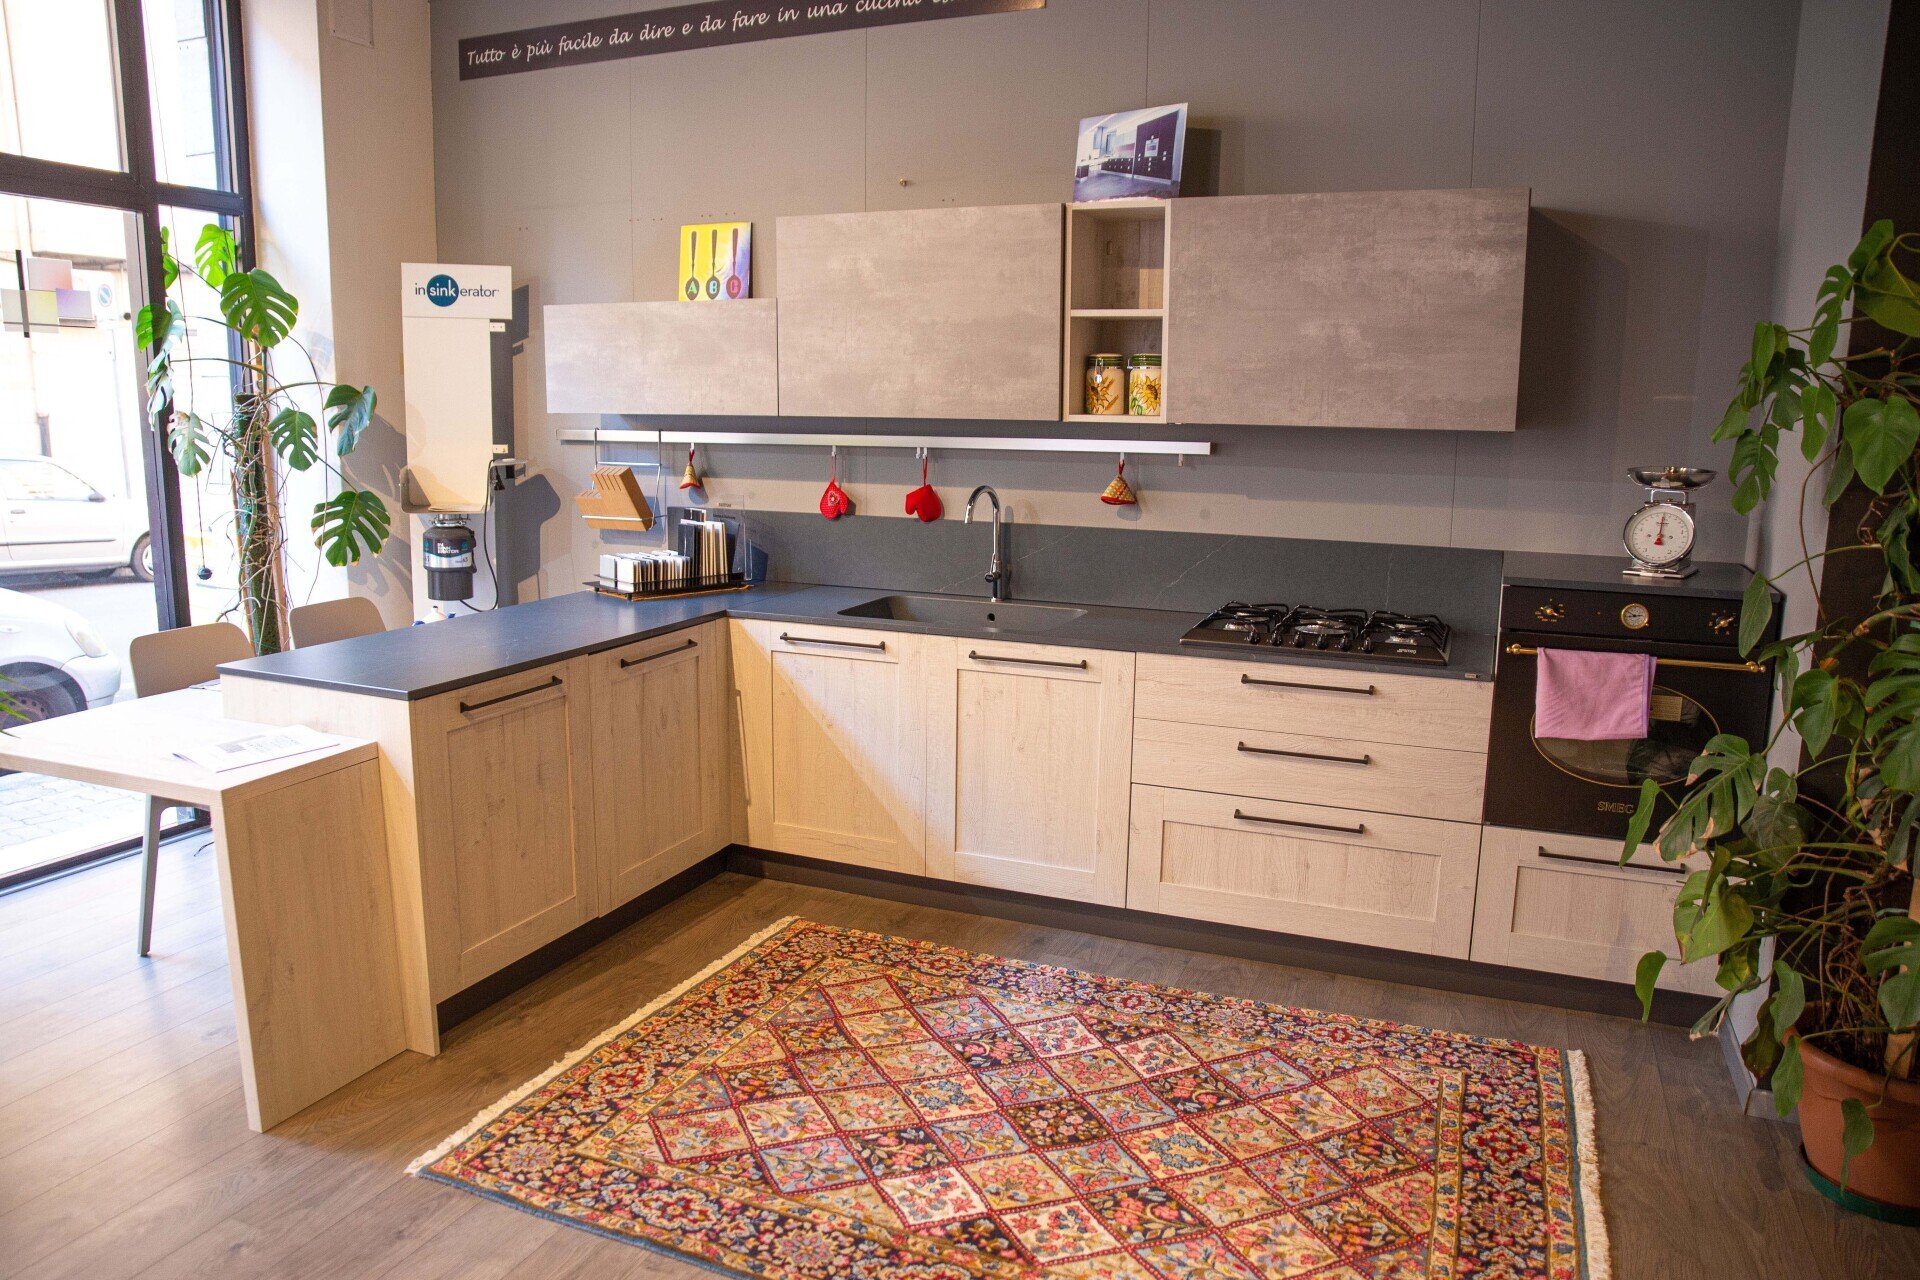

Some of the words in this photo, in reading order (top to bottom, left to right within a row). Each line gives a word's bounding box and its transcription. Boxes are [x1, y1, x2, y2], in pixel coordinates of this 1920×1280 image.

[467, 50, 505, 66] Tutto
[511, 45, 521, 59] è
[526, 39, 553, 62] più
[558, 32, 603, 55] facile
[609, 29, 633, 45] da
[640, 22, 675, 41] dire
[682, 24, 693, 35] e
[700, 15, 726, 32] da
[732, 10, 770, 32] fare
[777, 8, 800, 22] in
[807, 2, 847, 18] una
[1597, 801, 1635, 814] SMEG
